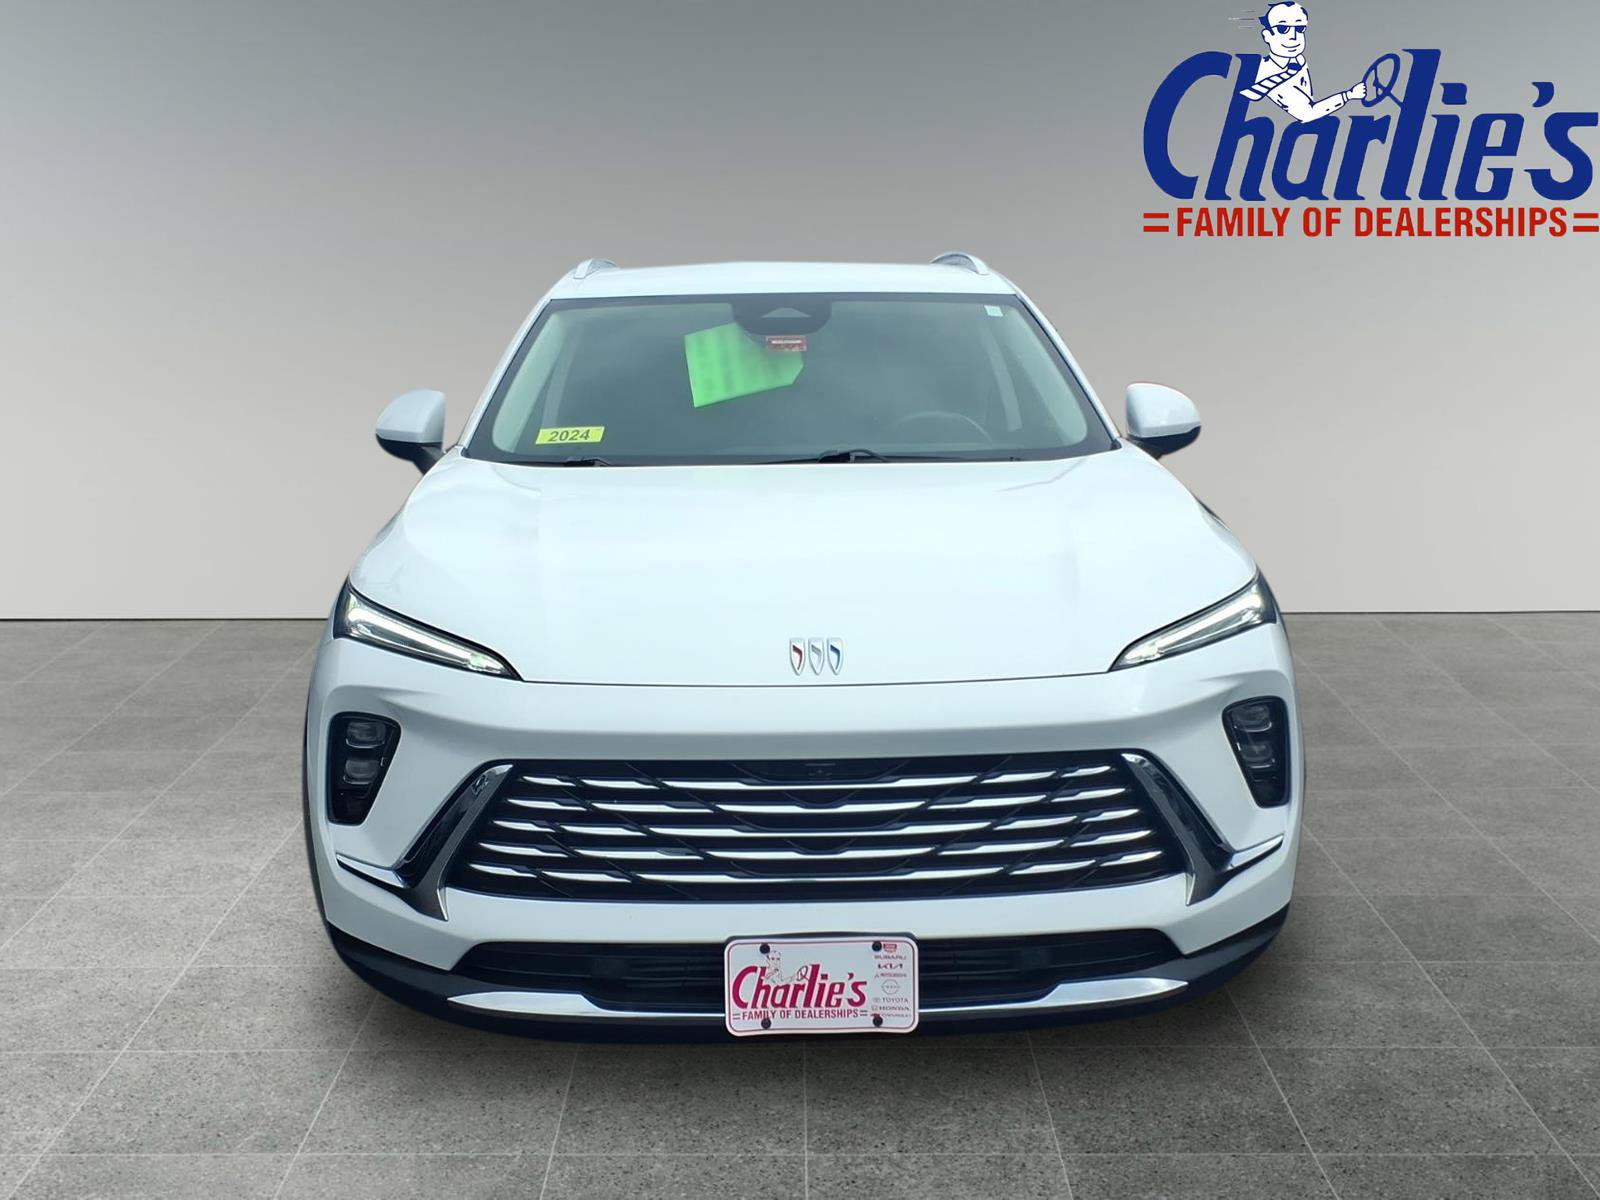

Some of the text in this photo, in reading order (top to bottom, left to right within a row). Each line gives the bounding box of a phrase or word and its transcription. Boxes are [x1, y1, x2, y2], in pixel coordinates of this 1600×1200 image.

[547, 429, 590, 442] 2024
[732, 964, 867, 1009] Charlie's
[742, 1009, 859, 1020] FAMILY OF DEALERSHIPS
